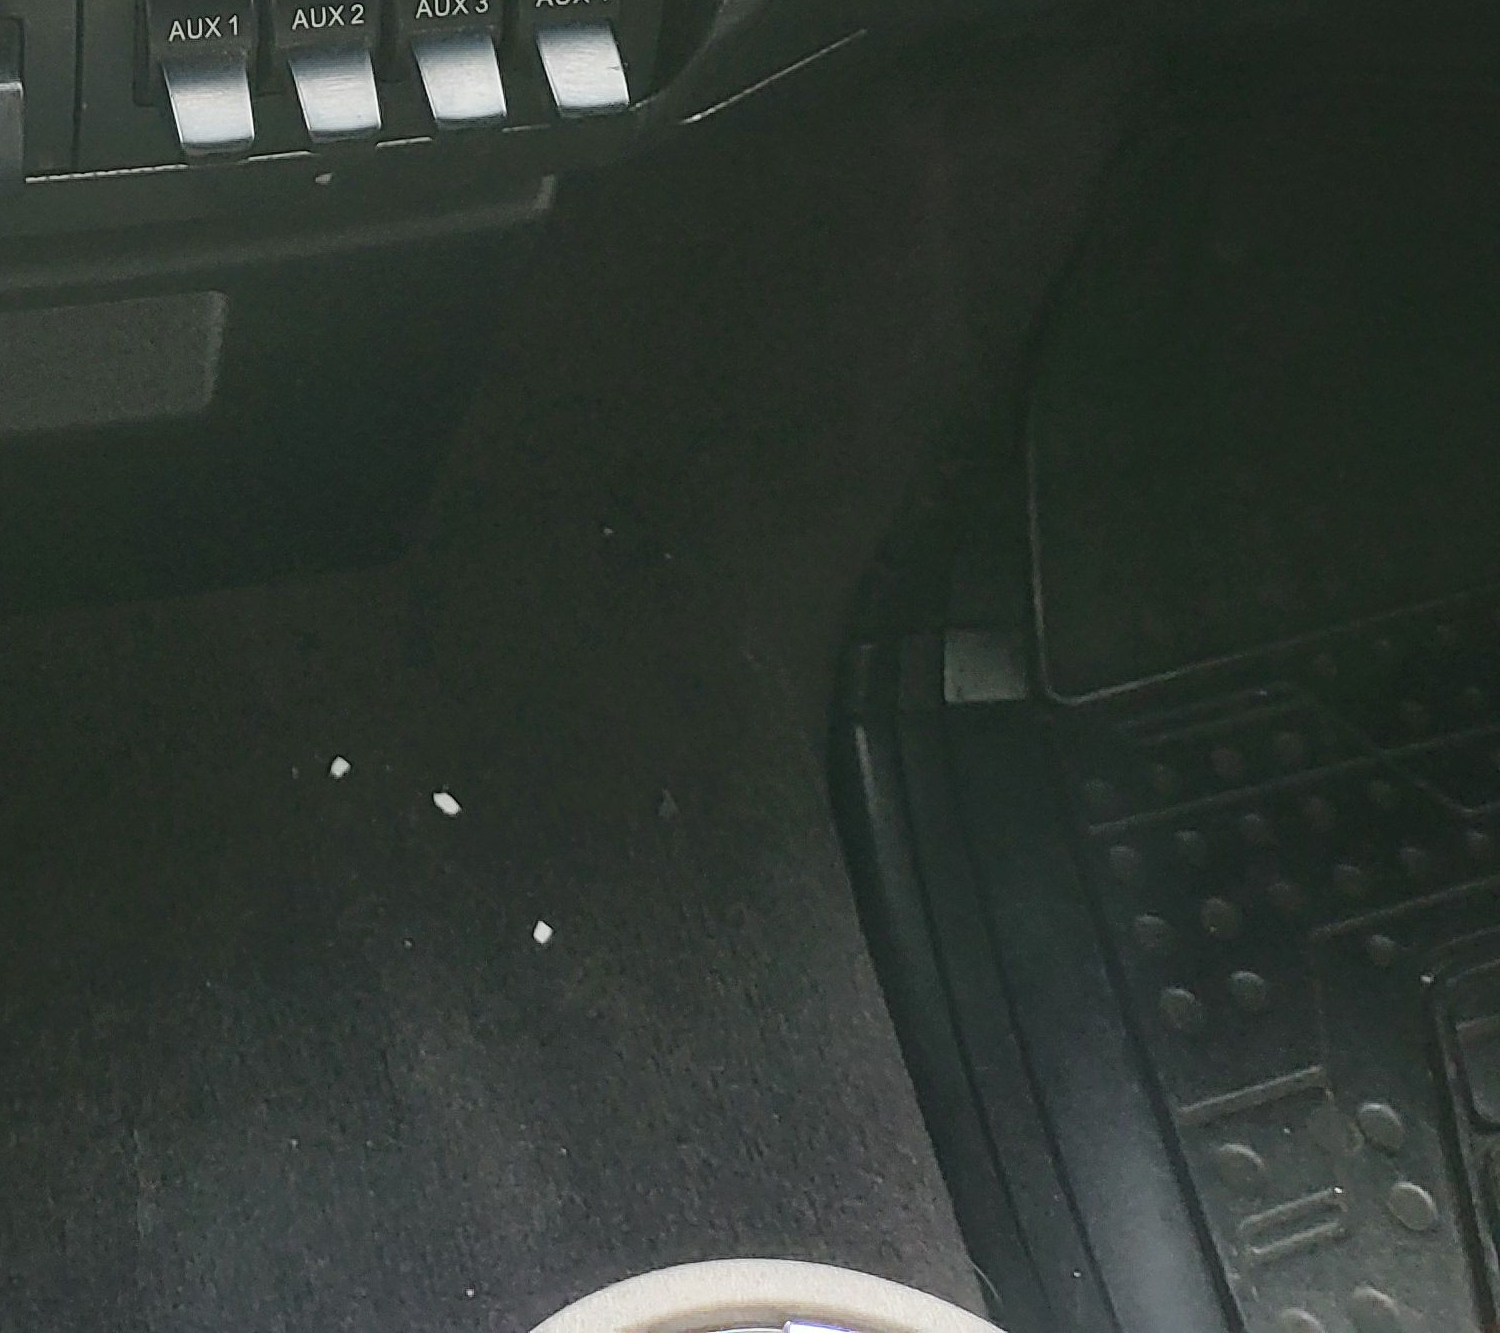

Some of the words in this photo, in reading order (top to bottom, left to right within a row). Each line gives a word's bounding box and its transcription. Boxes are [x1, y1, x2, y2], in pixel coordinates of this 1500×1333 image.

[168, 17, 224, 42] AUX
[228, 14, 243, 37] 1
[291, 5, 347, 31] AUX
[350, 3, 367, 26] 2
